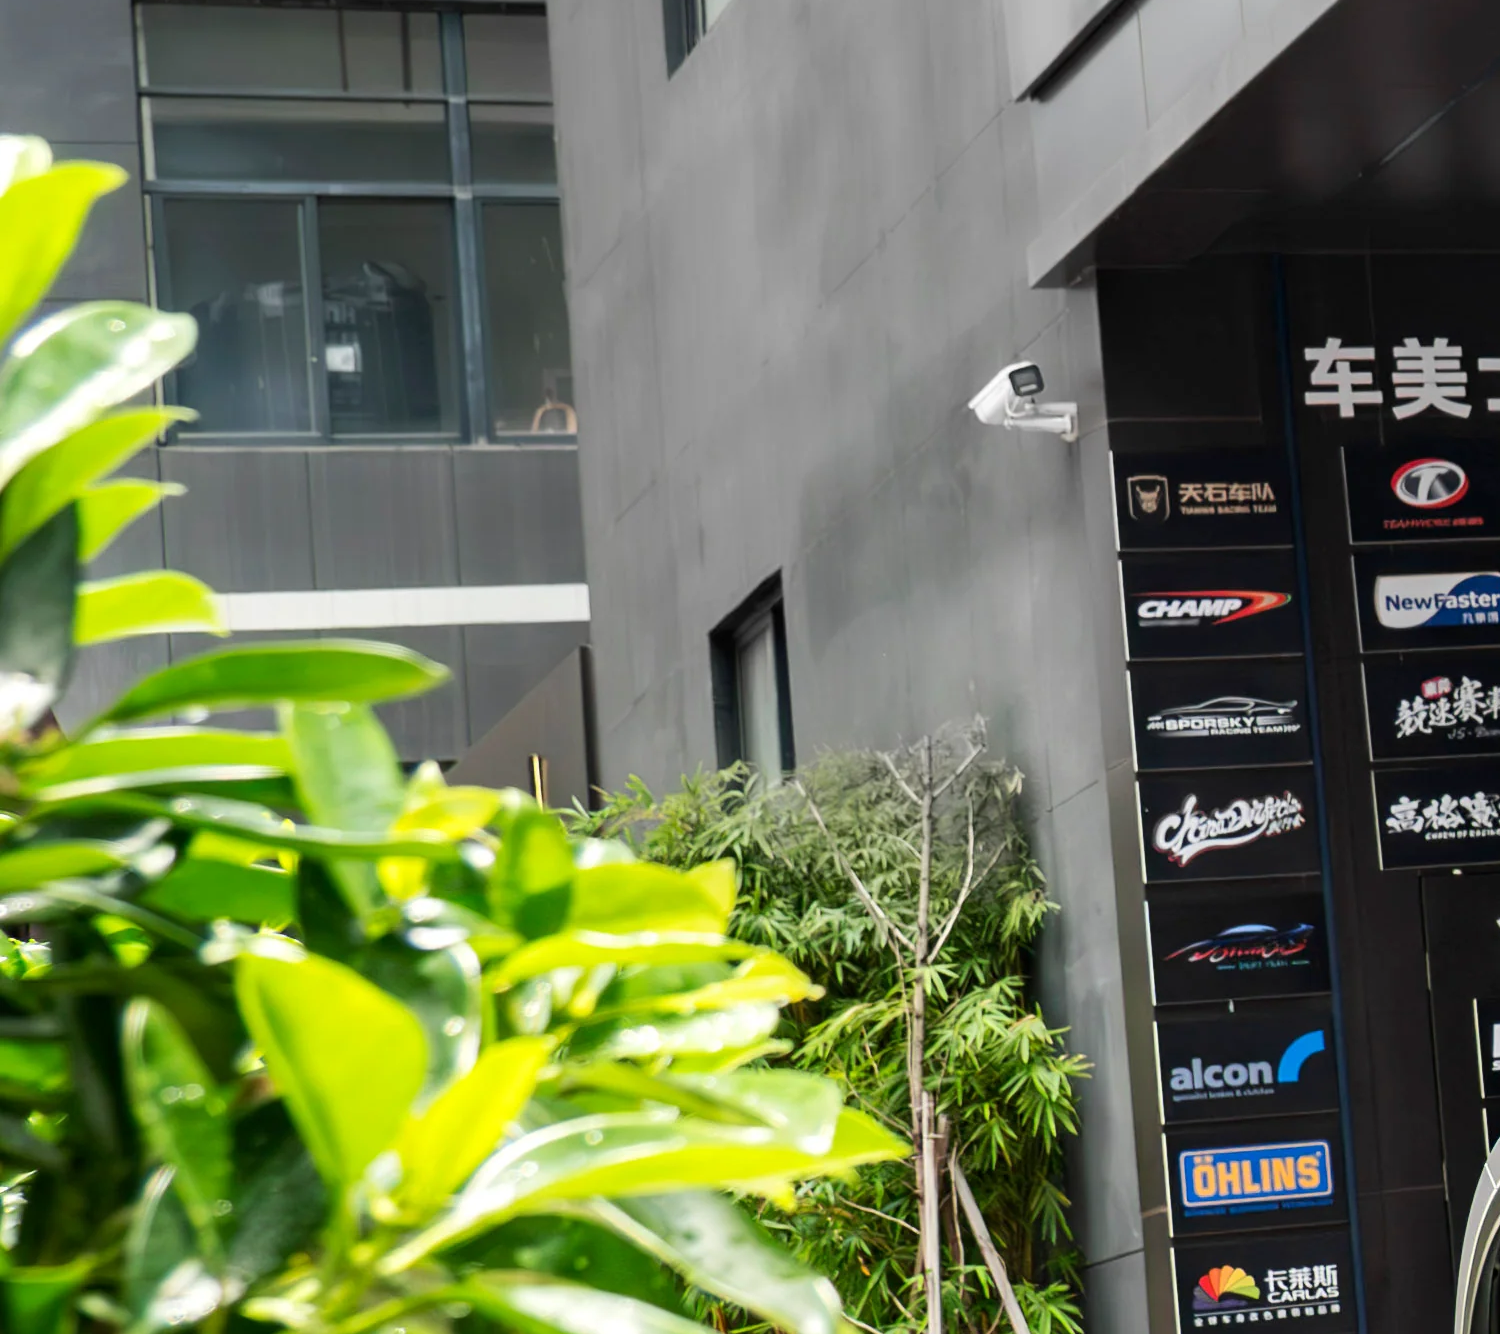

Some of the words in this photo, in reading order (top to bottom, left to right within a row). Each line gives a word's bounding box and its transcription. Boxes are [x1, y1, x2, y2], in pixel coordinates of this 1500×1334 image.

[1178, 482, 1276, 503] 天石车队
[1137, 598, 1243, 619] CHAMP
[1385, 591, 1500, 611] NewFaster
[1165, 716, 1255, 731] SPORSKY
[1170, 1057, 1273, 1091] alcon
[1193, 1155, 1320, 1197] ÖHLINS
[1264, 1264, 1338, 1292] 卡莱斯
[1267, 1287, 1339, 1304] CARLAS
